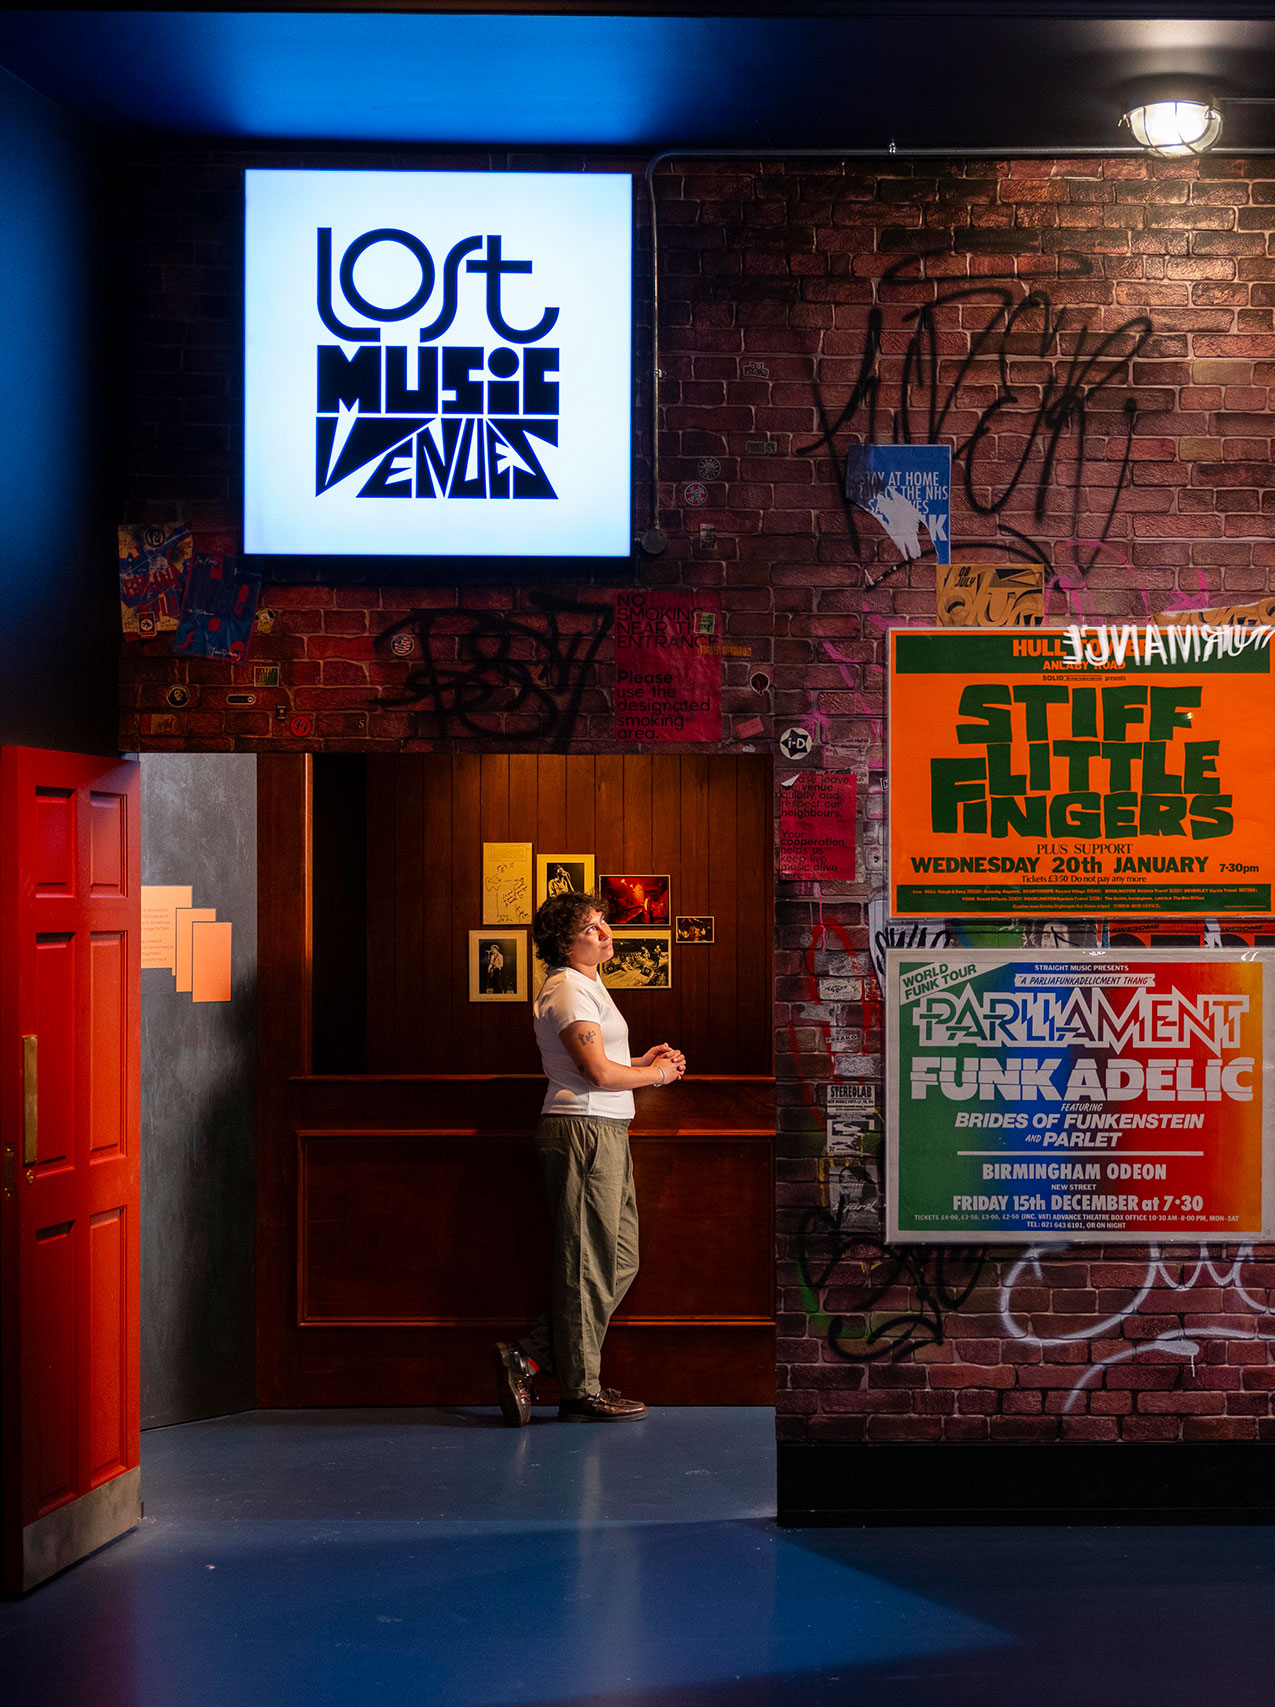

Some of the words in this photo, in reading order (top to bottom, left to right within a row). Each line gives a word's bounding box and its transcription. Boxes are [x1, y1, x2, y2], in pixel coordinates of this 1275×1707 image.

[315, 417, 558, 499] VENUES
[888, 472, 902, 485] AT
[906, 472, 939, 486] HOME
[902, 486, 923, 499] THE
[925, 486, 948, 500] NHS
[959, 567, 969, 576] 08
[954, 576, 976, 587] JULY
[617, 594, 645, 607] NO
[617, 622, 667, 634] NEAR
[617, 635, 719, 648] ENTRANCE
[1013, 639, 1067, 657] HULL
[1043, 661, 1089, 670] ANLABY
[617, 671, 672, 683] Please
[617, 687, 644, 698] use
[652, 686, 676, 697] the
[617, 699, 710, 714] designated
[956, 684, 1203, 744] STIFF
[618, 715, 684, 730] smoking
[617, 728, 659, 739] area.
[788, 738, 806, 749] i-D
[986, 740, 1220, 795] LITTLE
[1037, 844, 1069, 854] PLUS
[1074, 844, 1133, 854] SUPPORT
[911, 857, 1040, 872] WEDNESDAY
[1052, 857, 1102, 873] 20th
[1114, 856, 1209, 873] JANUARY
[1022, 875, 1047, 883] Tickets
[1097, 876, 1110, 884] pay
[1112, 876, 1125, 884] any
[902, 963, 949, 988] WORLD
[905, 978, 943, 1000] FUNK
[943, 963, 977, 985] TOUR
[1029, 976, 1120, 985] PARLIAFUNKADELICMENT
[913, 983, 1250, 1056] PARLIAMENT
[911, 1057, 1255, 1101] FUNKADELIC
[831, 1086, 871, 1097] STEREOLAB
[1061, 1103, 1102, 1112] FEATURING
[955, 1112, 1034, 1128] BRIDES
[1037, 1112, 1060, 1128] OF
[1064, 1113, 1204, 1129] FUNKENSTEIN
[1025, 1134, 1042, 1143] AND
[1043, 1132, 1122, 1147] PARLET
[983, 1164, 1101, 1179] BIRMINGHAM
[1107, 1163, 1166, 1179] ODEON
[953, 1195, 1009, 1211] FRIDAY
[1013, 1195, 1046, 1211] 15th
[1051, 1195, 1138, 1211] DECEMBER
[1142, 1197, 1160, 1211] at
